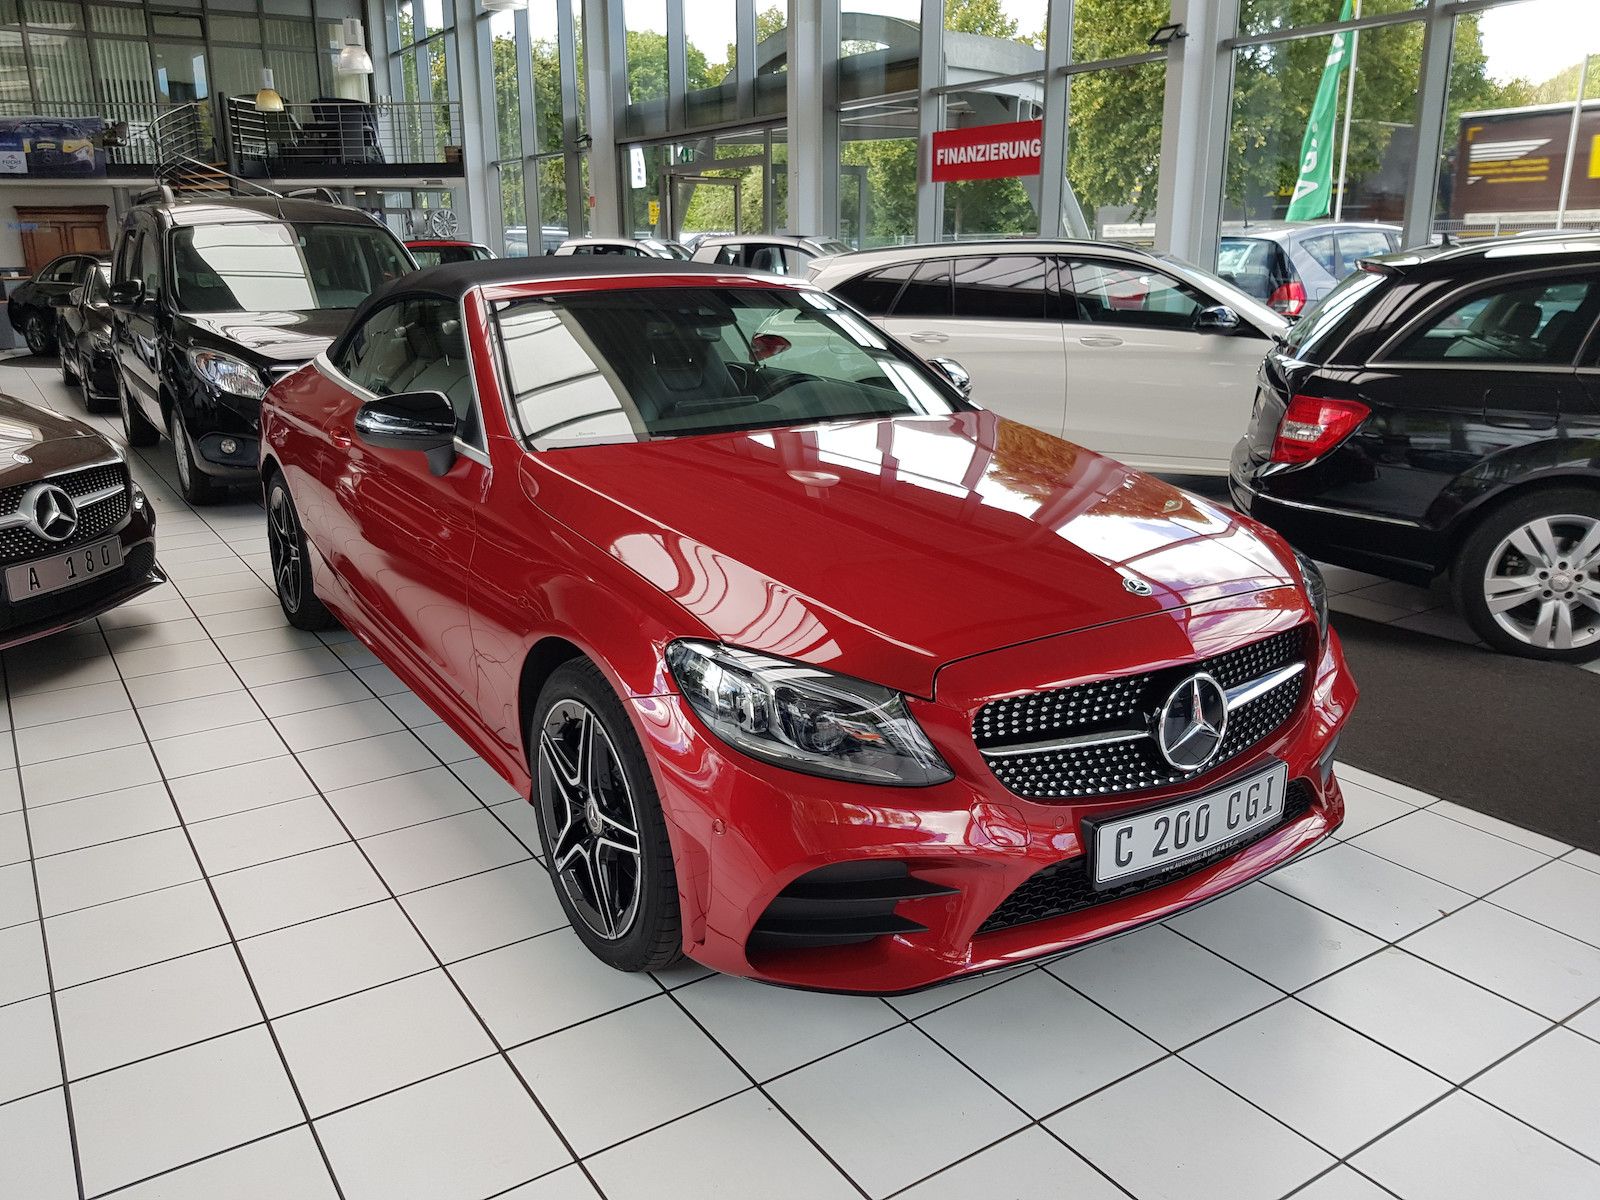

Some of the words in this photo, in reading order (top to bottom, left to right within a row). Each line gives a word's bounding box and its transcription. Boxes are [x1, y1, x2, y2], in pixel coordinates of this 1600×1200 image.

[937, 139, 1042, 166] FINANZIERUNG
[28, 567, 40, 591] A
[65, 545, 110, 580] 180
[1115, 826, 1133, 868] C
[1152, 803, 1211, 858] 200
[1226, 775, 1275, 830] CGI
